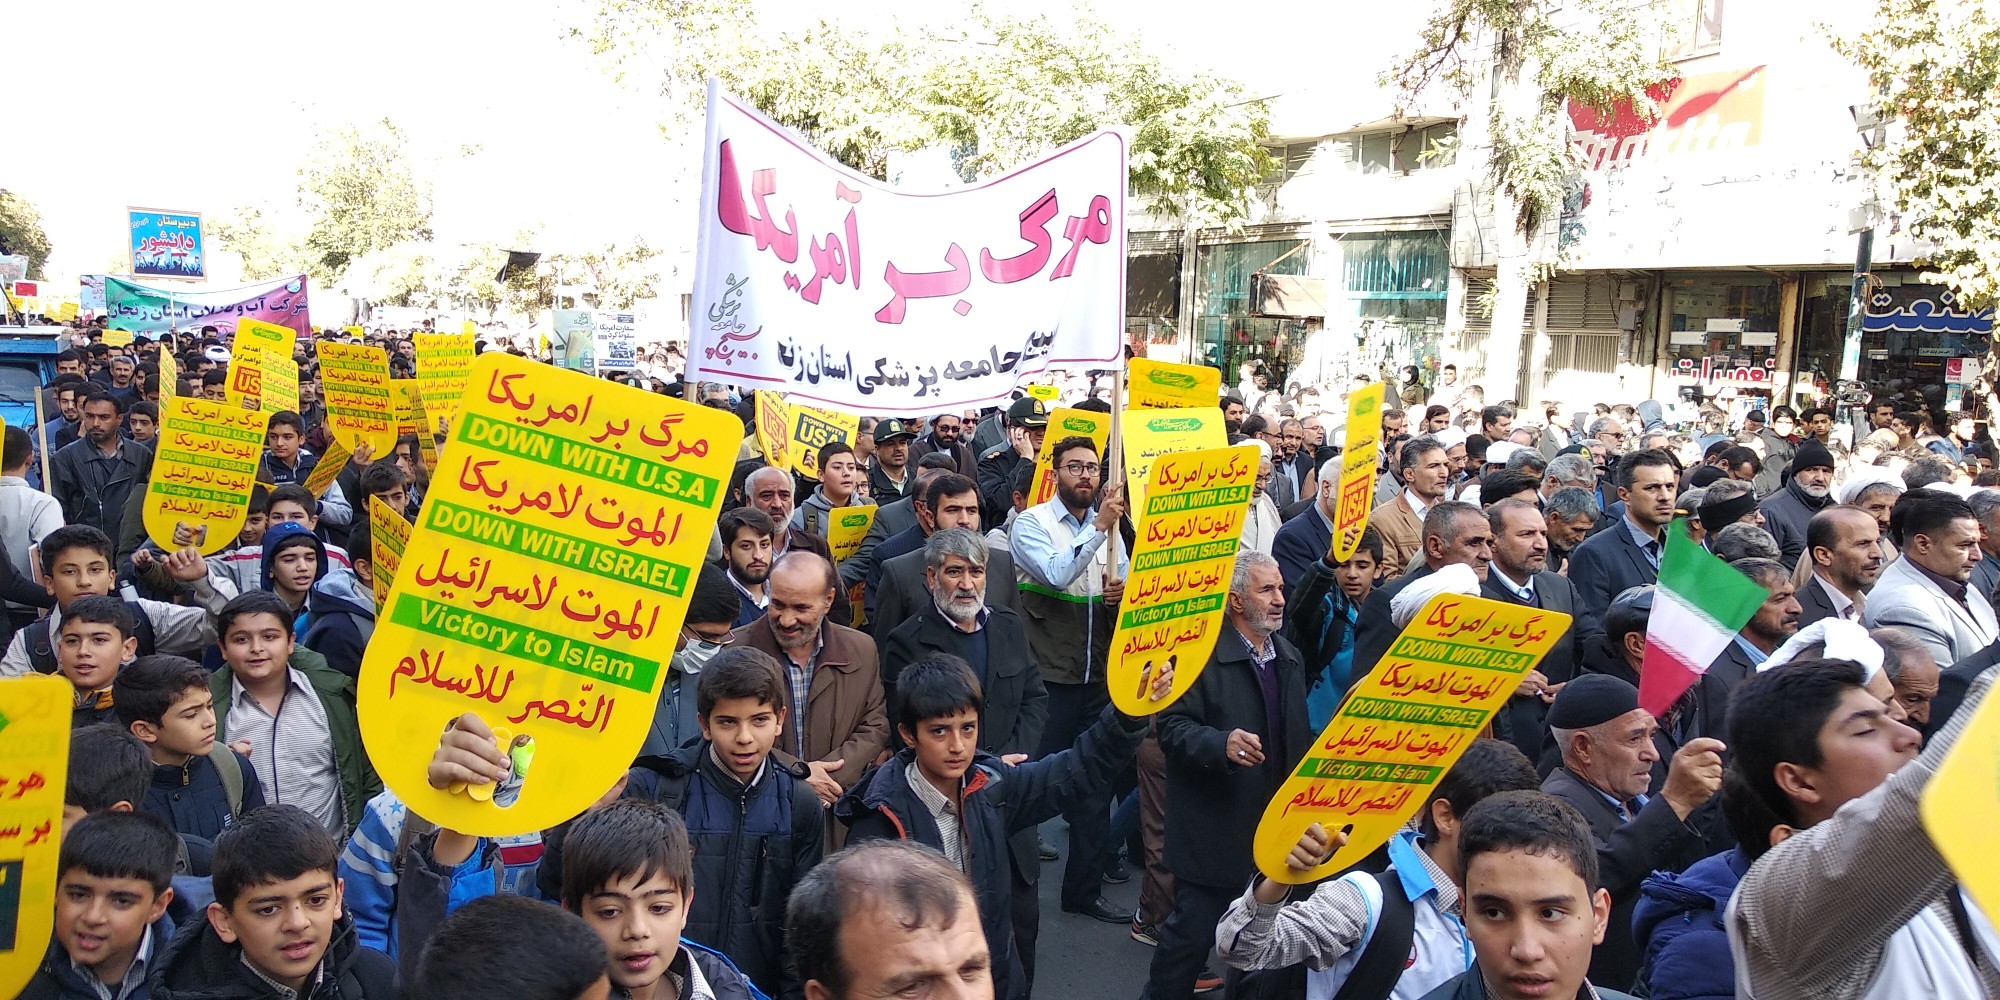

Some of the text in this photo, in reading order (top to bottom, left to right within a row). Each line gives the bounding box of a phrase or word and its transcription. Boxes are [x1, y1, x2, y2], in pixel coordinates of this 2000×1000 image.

[157, 215, 197, 228] دبیرستان
[980, 188, 1112, 284] مرگ
[874, 242, 972, 324] بر
[107, 301, 148, 320] زنجان
[150, 303, 189, 321] استان
[236, 304, 244, 316] و
[245, 297, 266, 312] آب
[269, 297, 308, 315] شرکت
[321, 345, 380, 362] مرگ بر امریکا
[346, 362, 364, 370] WITH
[806, 344, 852, 385] استان
[943, 345, 1022, 381] جامعه
[237, 374, 261, 395] US
[326, 368, 383, 385] الموت لامریکا
[346, 385, 364, 393] WITH
[857, 357, 938, 396] پزشکی
[329, 393, 388, 409] الموت لاسرائیل
[486, 368, 594, 428] امریکا
[181, 401, 263, 430] مرگ بر امریکا
[334, 407, 359, 417] Victory
[368, 411, 388, 419] Islam
[336, 417, 364, 430] للاسلام
[803, 415, 844, 437] DOWN WITH
[170, 419, 260, 443] DOWN WITH U.S.A
[591, 417, 631, 451] بر
[640, 411, 709, 462] مرگ
[764, 410, 787, 451] USA
[800, 423, 840, 449] USA
[175, 432, 256, 459] الموت لامریکا
[467, 416, 557, 460] DOWN
[560, 440, 627, 480] WITH
[635, 459, 705, 501] U.S.A
[161, 449, 254, 473] DOWN WITH ISRAEL
[1158, 454, 1248, 493] مرگ بر امریکا
[163, 465, 250, 491] الموت لاسرائیل
[159, 498, 203, 516] للاسلام
[161, 483, 240, 504] Victory to Islam
[459, 455, 683, 548] الموت لامریکا
[1150, 485, 1248, 514] DOWN WITH U.S.A
[1341, 488, 1365, 525] USA
[373, 501, 391, 529] امریکا
[1147, 510, 1236, 548] الموت لامریکا
[432, 504, 680, 592] DOWN WITH ISRAEL
[1136, 540, 1234, 571] DOWN WITH ISRAEL
[415, 548, 557, 612] لاسرائیل
[1129, 563, 1226, 606] الموت لاسرائیل
[561, 589, 660, 641] الموت
[1132, 597, 1216, 625] Victory to Islam
[1426, 600, 1548, 648] مرگ بر امریکا
[419, 601, 634, 680] Victory to Islam
[1120, 626, 1171, 668] للاسلام
[1397, 637, 1531, 672] DOWN WITH U.S.A
[389, 650, 515, 704] للاسلام
[1379, 662, 1506, 704] الموت لامریکا
[1348, 697, 1482, 726] DOWN WITH ISRAEL
[1325, 723, 1462, 760] الموت لاسرائیل
[1314, 758, 1430, 781] Victory to Islam
[9, 771, 46, 800] هر
[1281, 784, 1352, 819] للاسلام
[24, 818, 51, 847] بر
